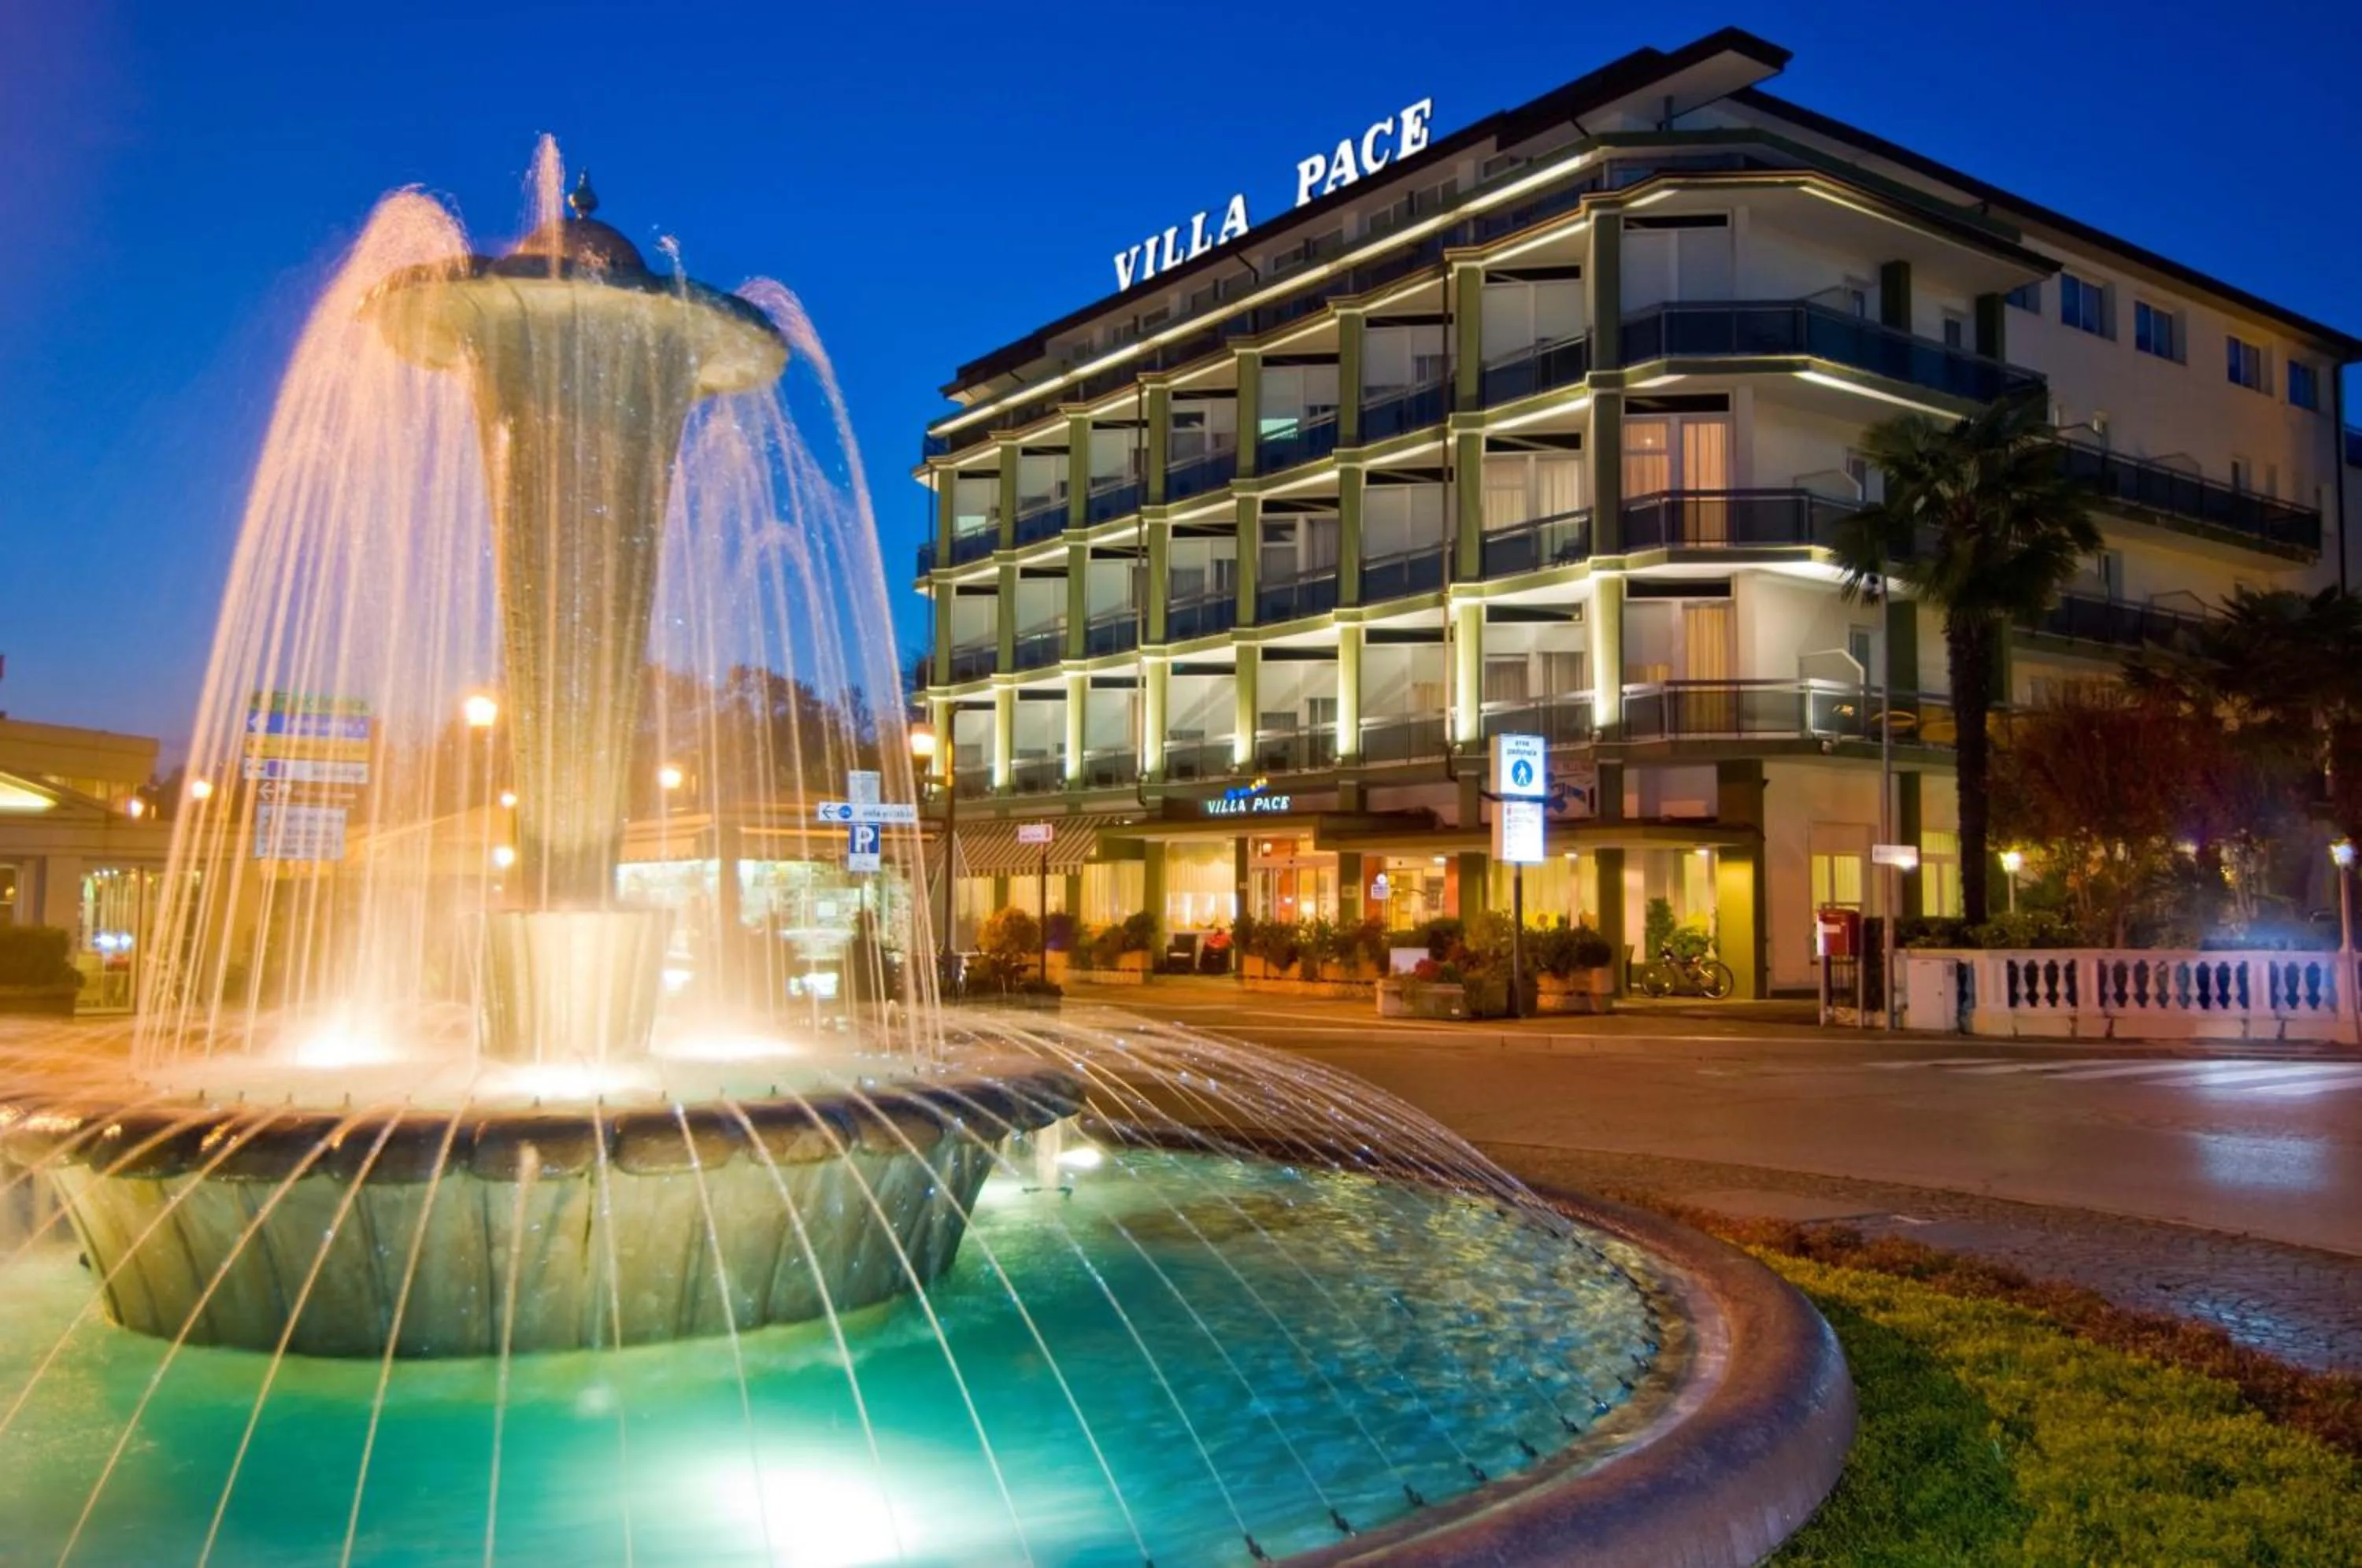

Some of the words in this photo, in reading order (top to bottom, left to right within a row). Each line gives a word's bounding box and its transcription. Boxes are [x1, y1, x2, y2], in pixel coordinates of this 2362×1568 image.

[1113, 193, 1249, 292] VILLA
[1295, 97, 1433, 208] PACE
[1209, 799, 1246, 813] VILLA
[1253, 796, 1290, 811] PACE
[854, 826, 875, 852] P
